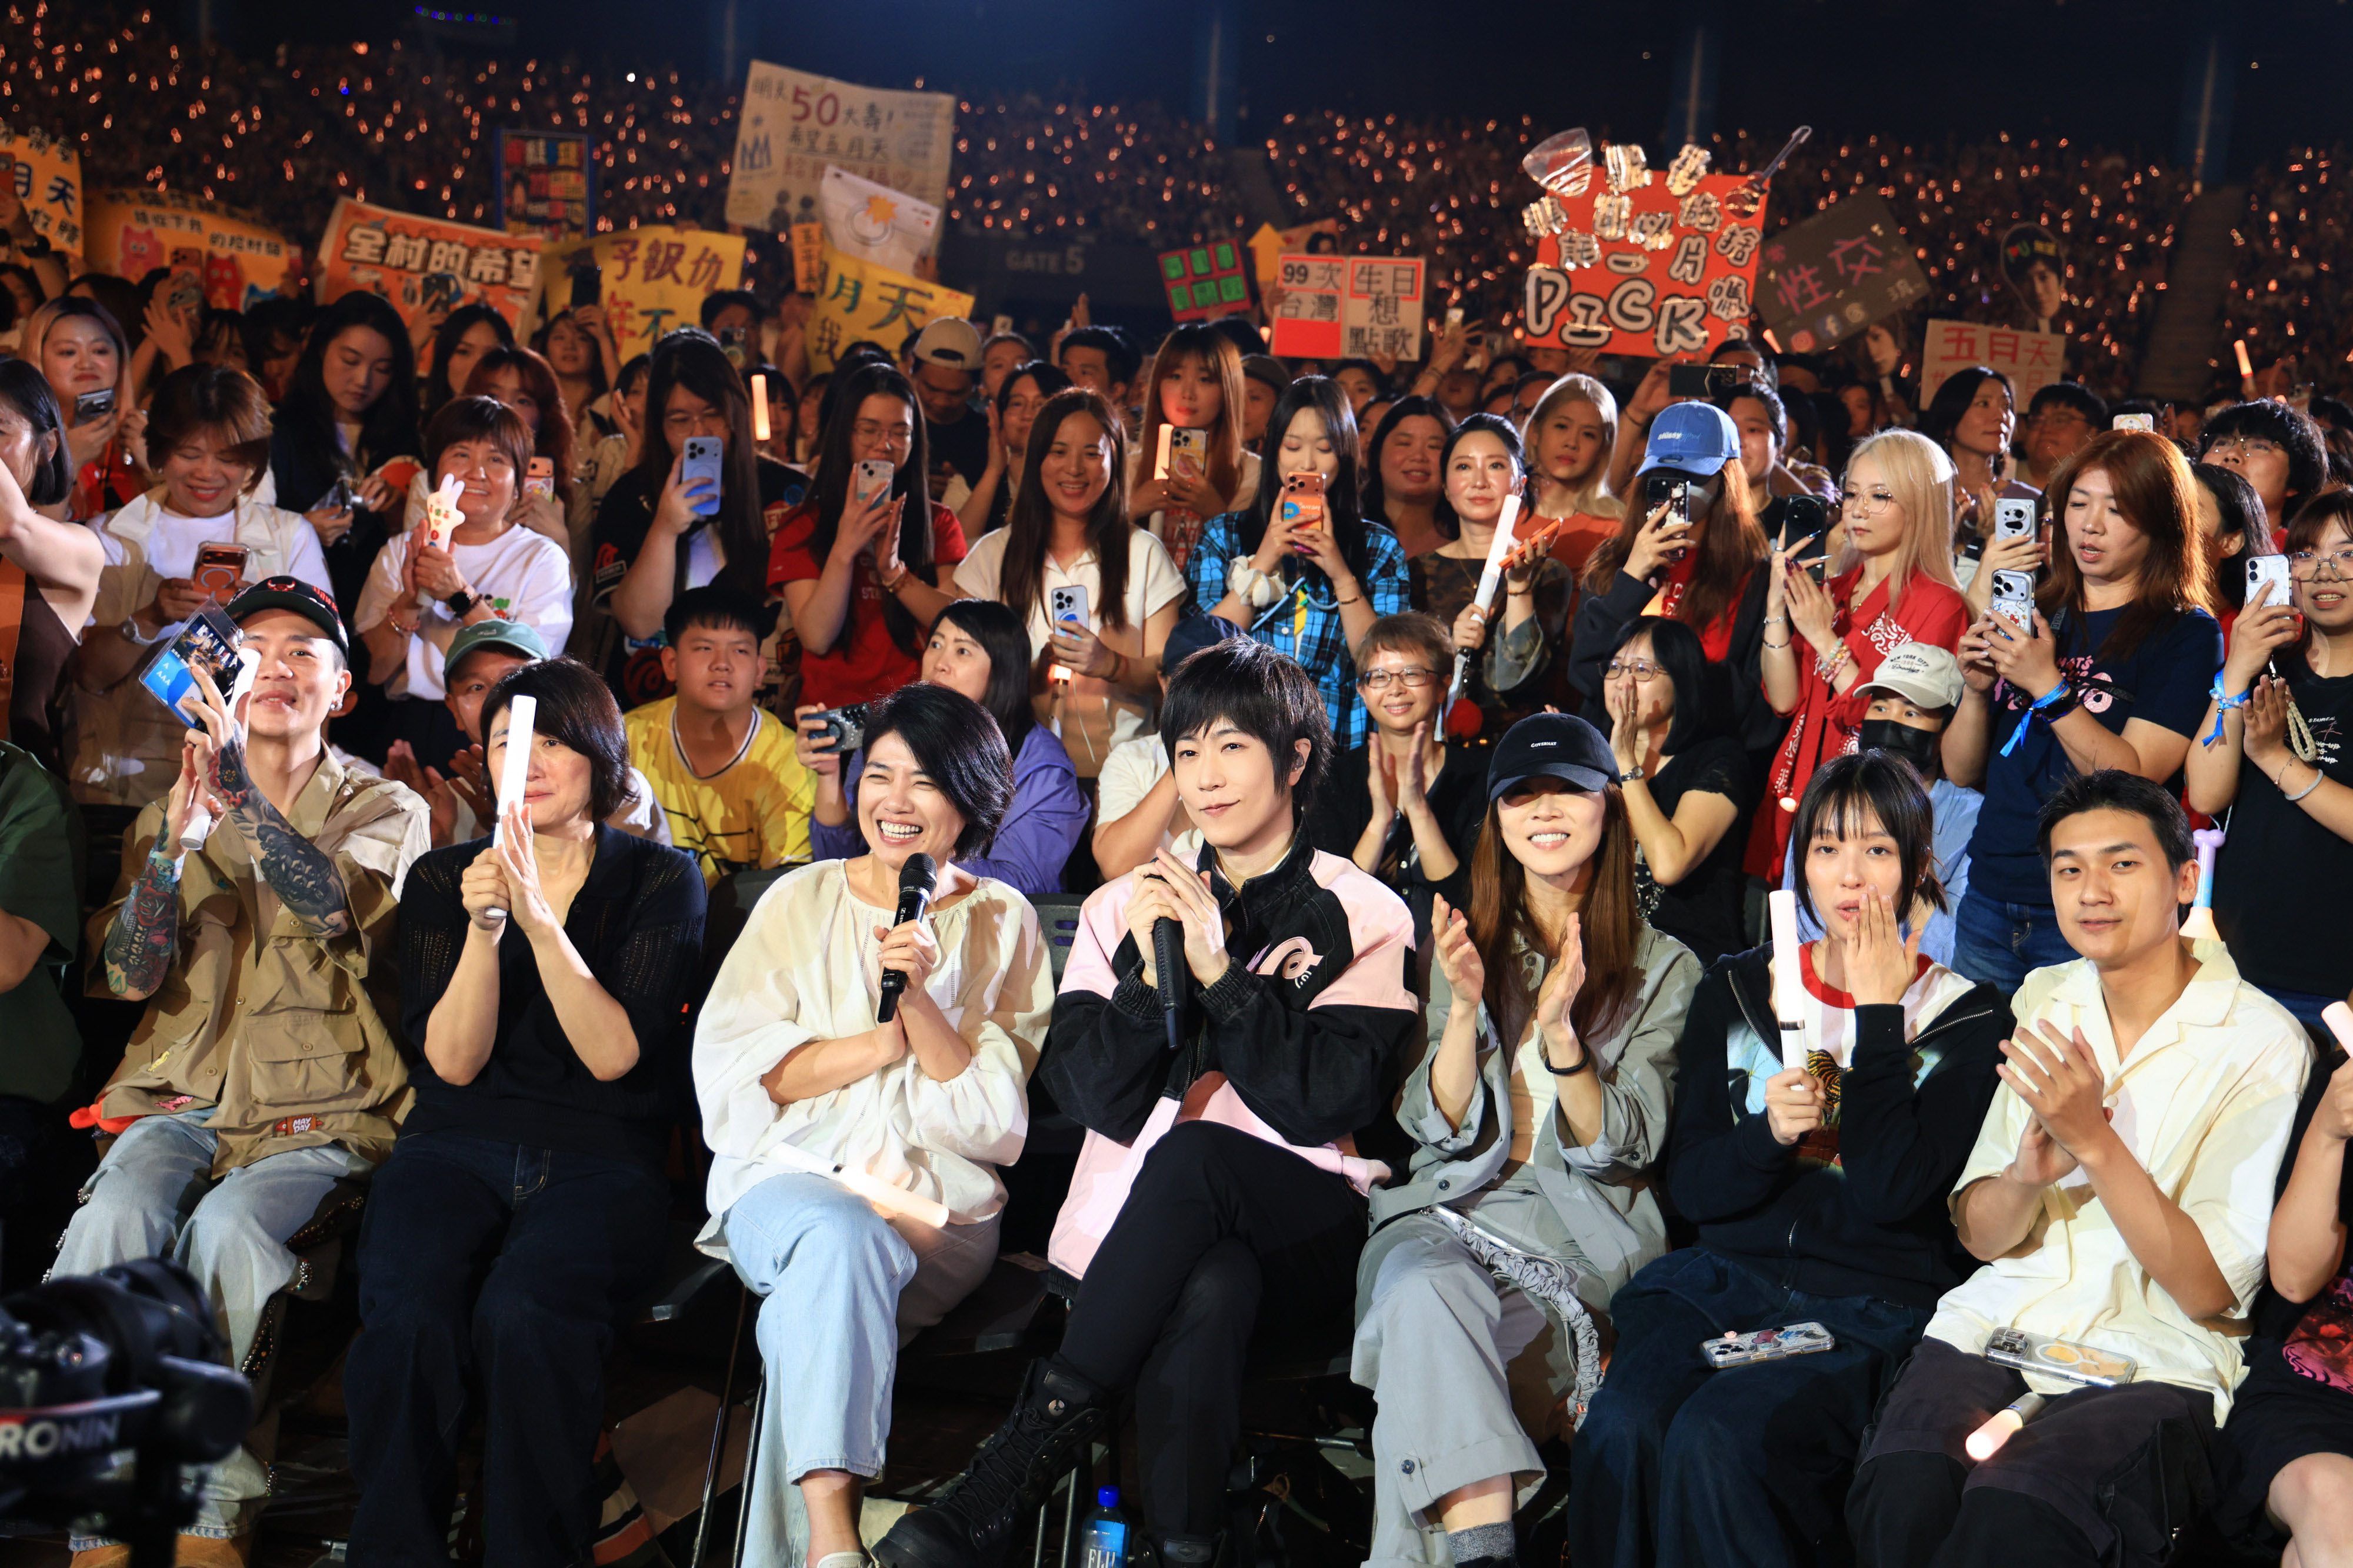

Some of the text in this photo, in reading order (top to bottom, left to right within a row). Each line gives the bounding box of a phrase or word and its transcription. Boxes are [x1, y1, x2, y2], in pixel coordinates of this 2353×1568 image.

[561, 238, 724, 293] 子報仇
[820, 261, 934, 336] 月天
[1939, 326, 2058, 367] 五月天
[293, 1117, 312, 1127] MAY
[294, 1123, 311, 1133] DAY
